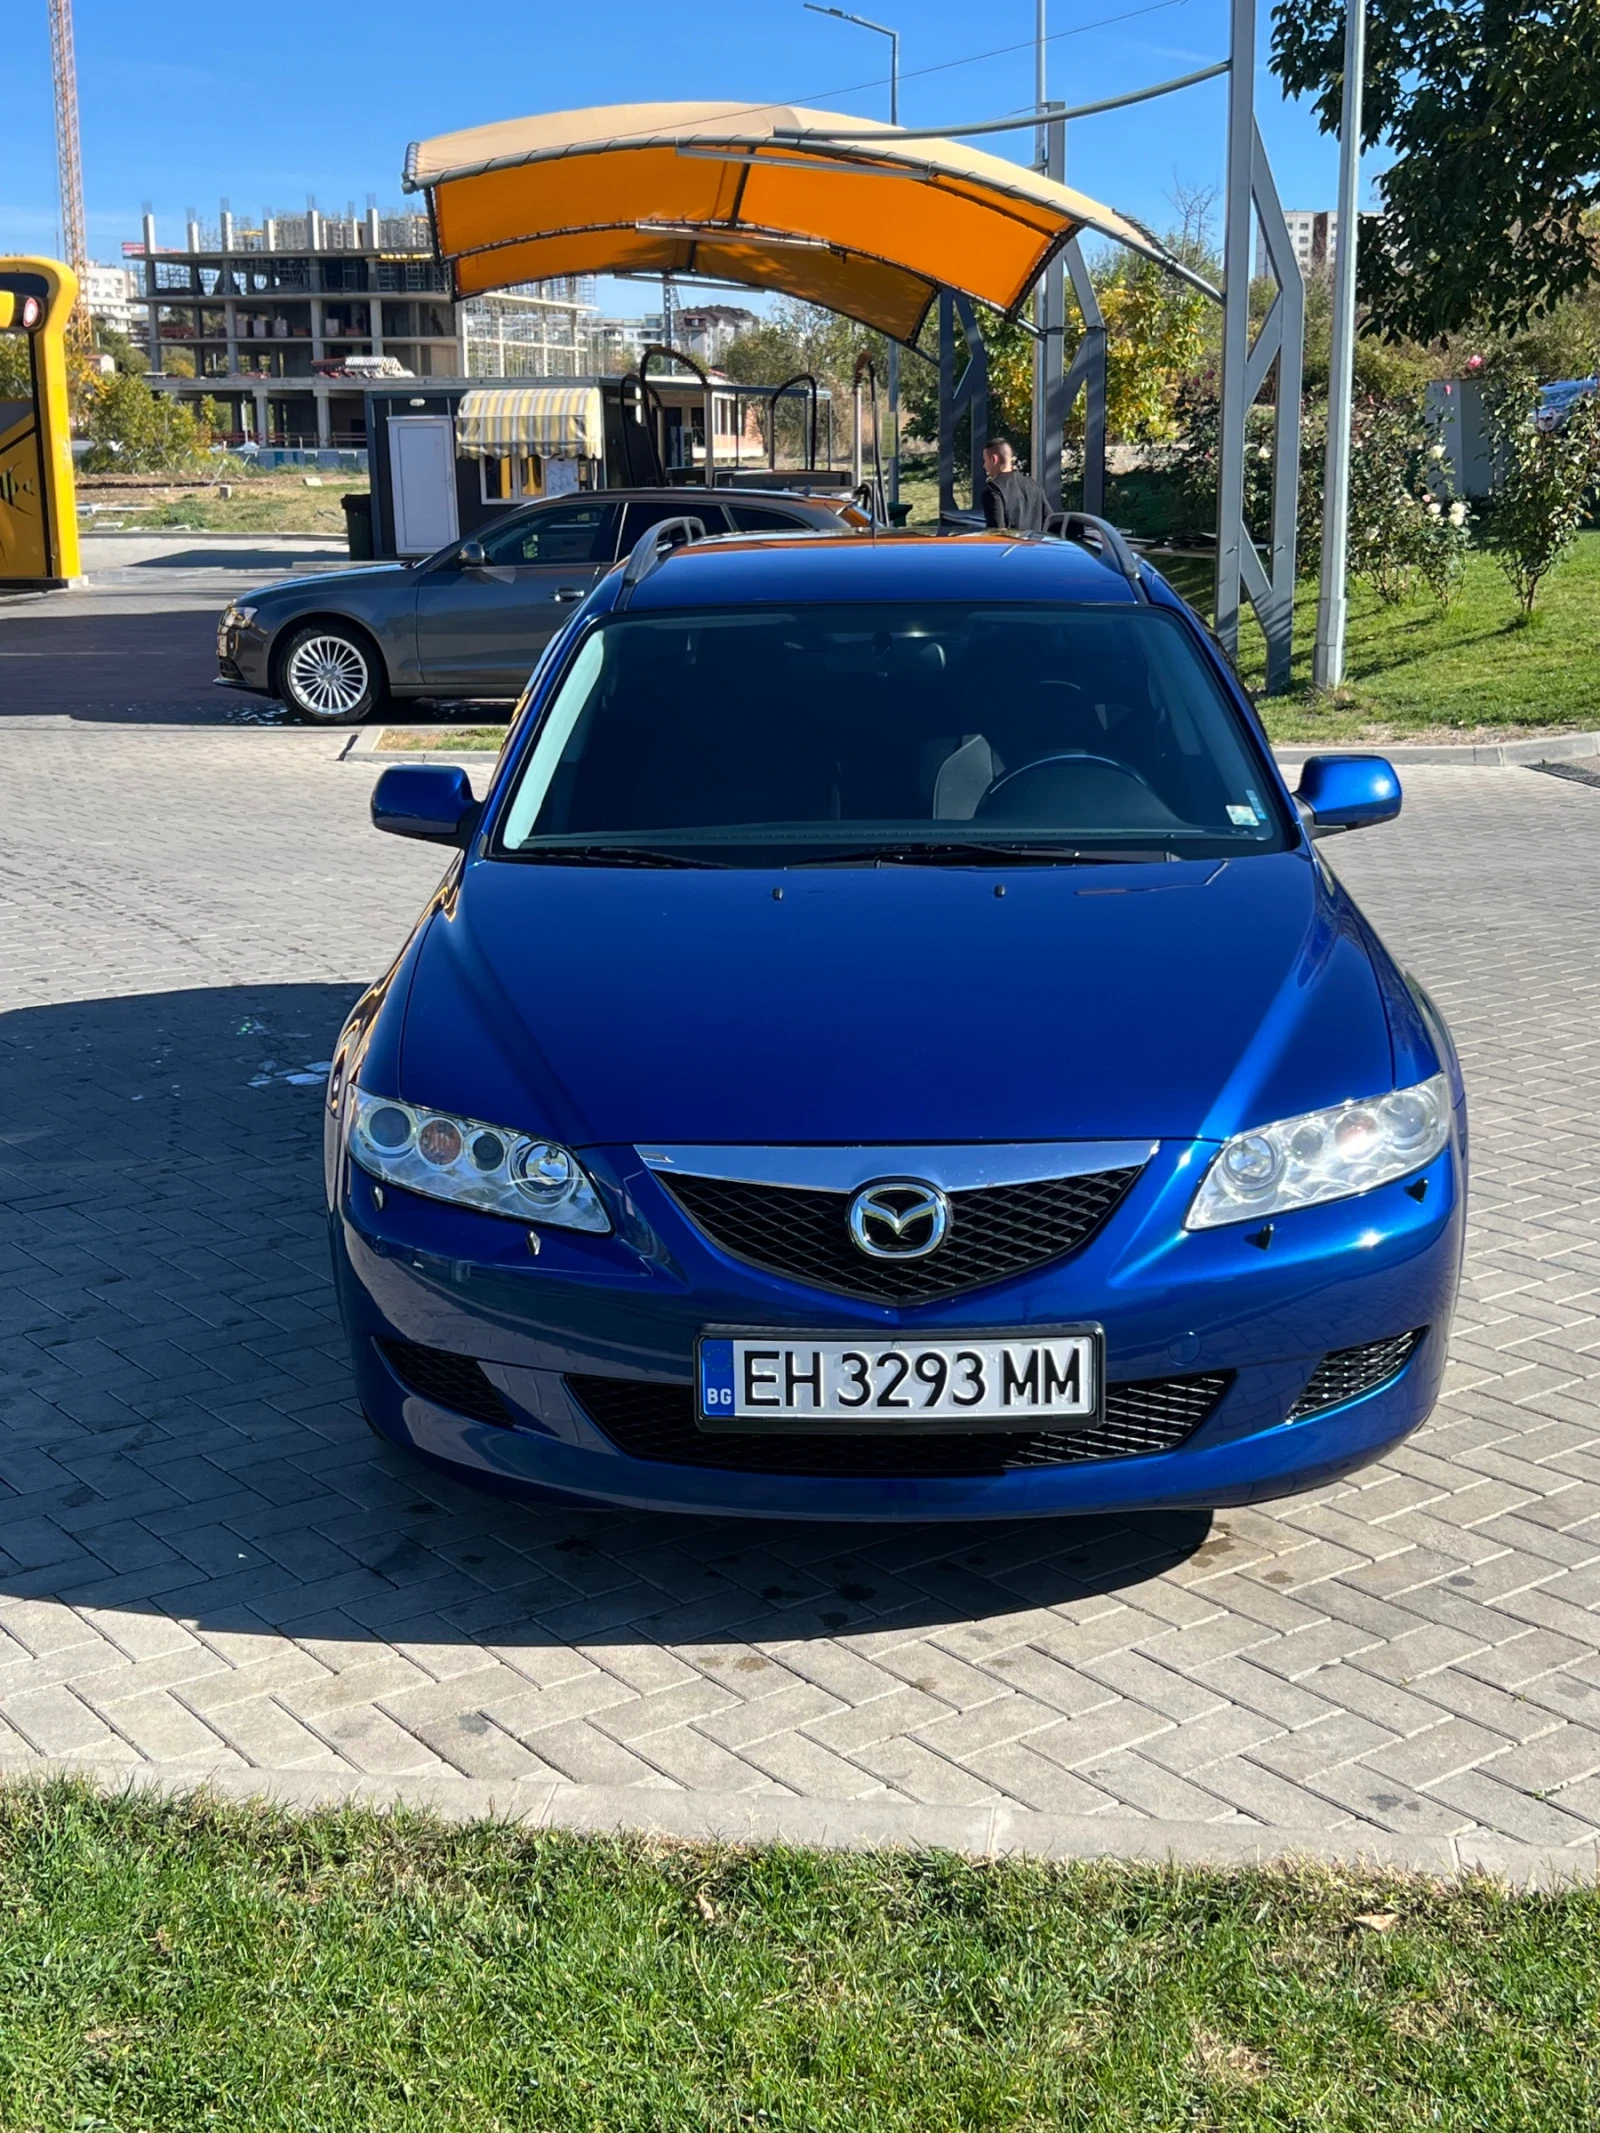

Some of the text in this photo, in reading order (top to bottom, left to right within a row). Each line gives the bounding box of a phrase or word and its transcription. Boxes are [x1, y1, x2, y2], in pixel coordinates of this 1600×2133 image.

[706, 1388, 732, 1405] BG
[744, 1346, 1081, 1408] EH 3293 MM
